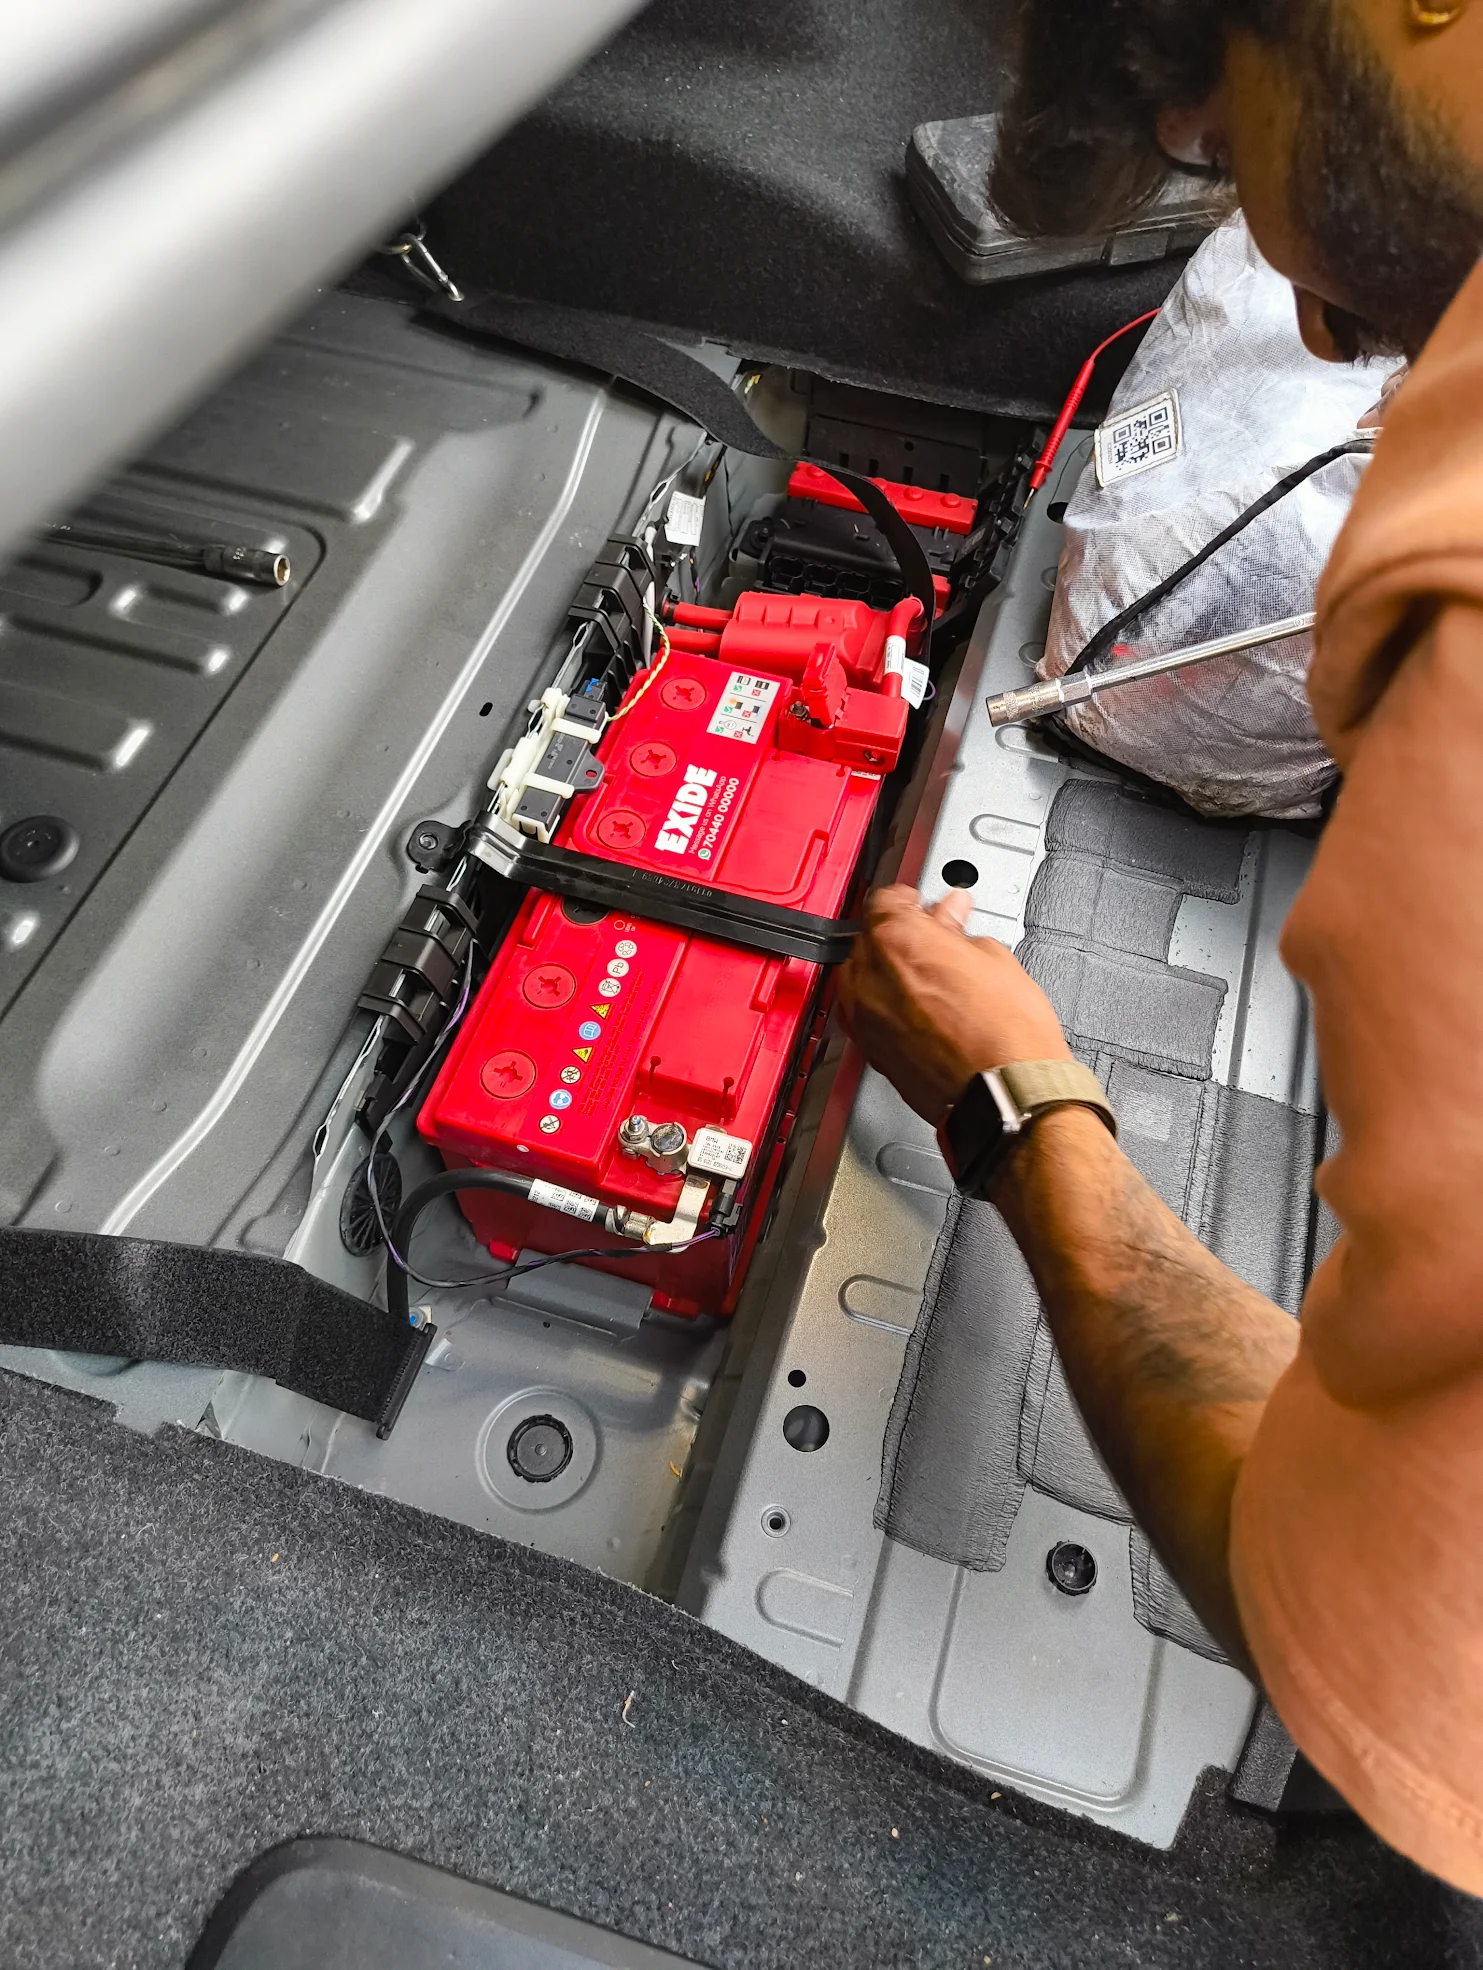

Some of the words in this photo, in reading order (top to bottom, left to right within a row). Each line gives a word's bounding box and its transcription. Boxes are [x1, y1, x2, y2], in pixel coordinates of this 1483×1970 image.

[708, 776, 726, 808] WhatsApp
[654, 764, 718, 855] EXIDE
[702, 818, 709, 826] us
[703, 814, 724, 848] 70440
[717, 778, 739, 813] 00000
[705, 808, 712, 817] on
[688, 826, 705, 854] Message
[612, 961, 624, 975] Pb
